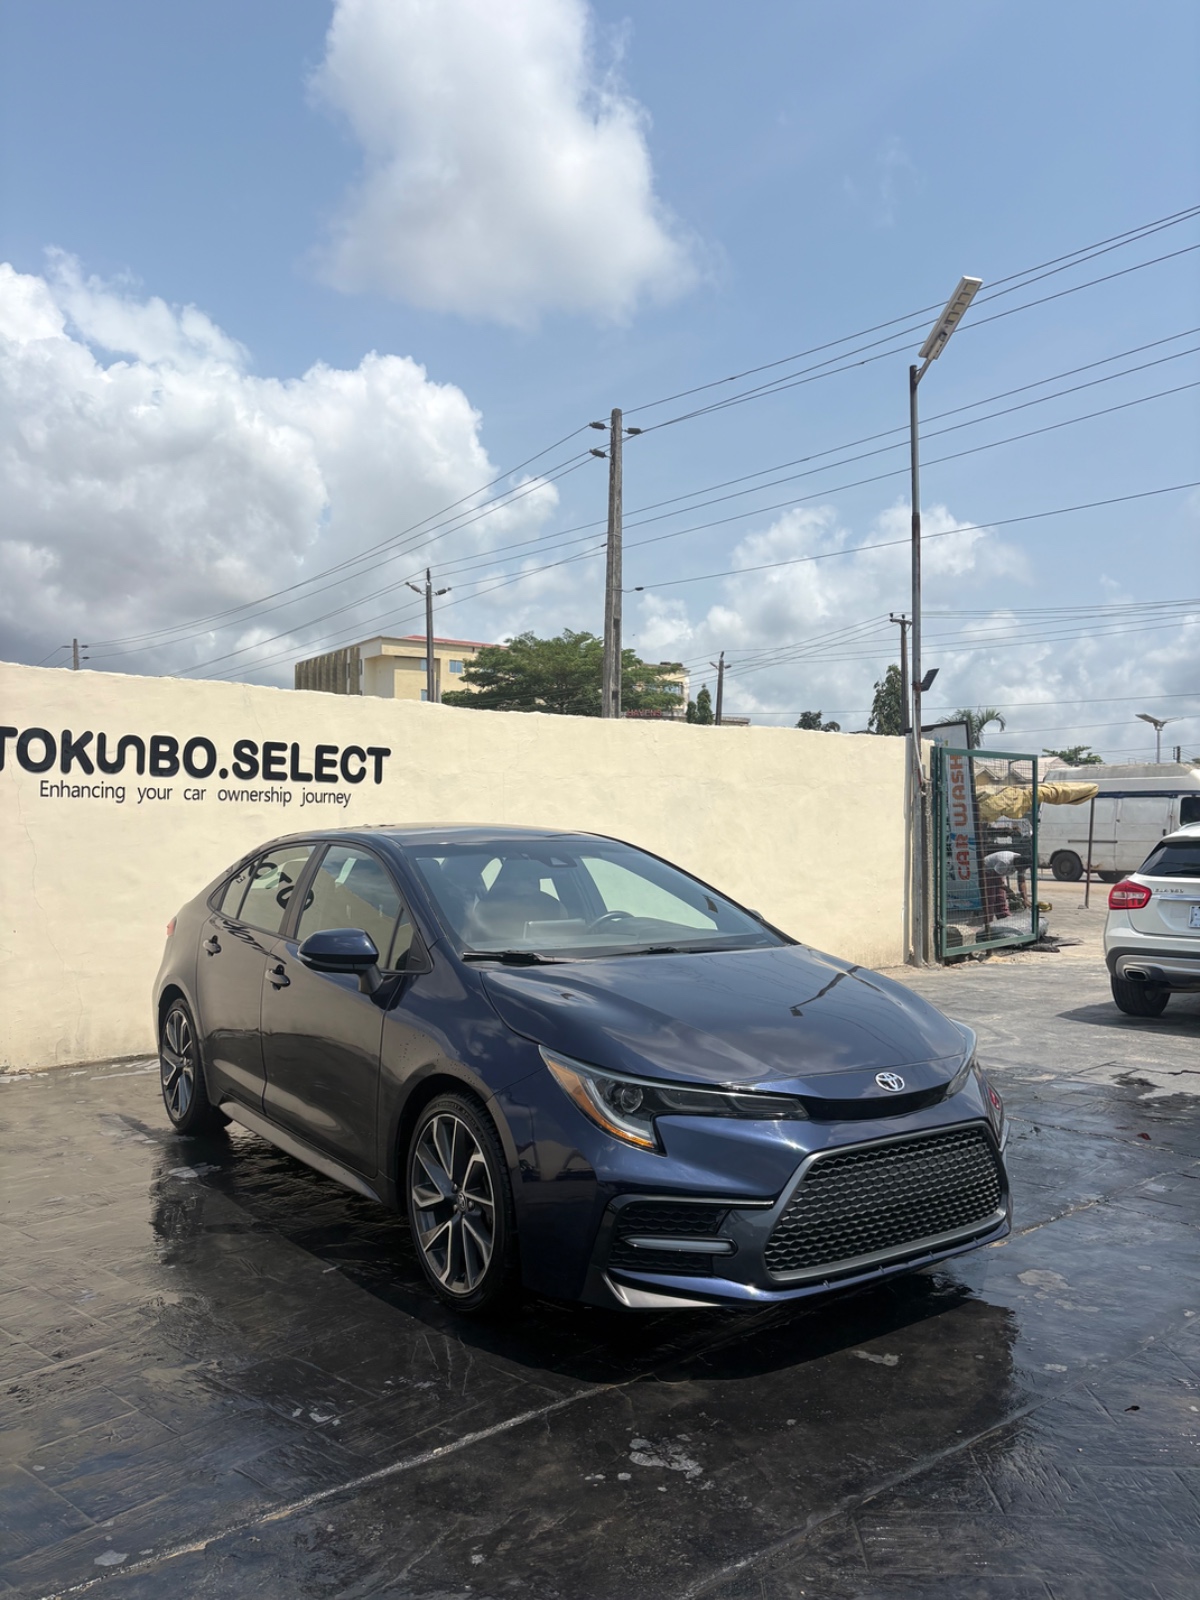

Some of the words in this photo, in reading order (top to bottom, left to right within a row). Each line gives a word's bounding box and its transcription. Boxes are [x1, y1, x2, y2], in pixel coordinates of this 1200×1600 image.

[40, 780, 126, 803] Enhancing
[137, 787, 173, 804] your
[183, 788, 207, 801] car
[218, 786, 292, 807] ownership
[300, 789, 352, 808] journey
[950, 754, 969, 827] WASH
[955, 833, 971, 881] CAR
